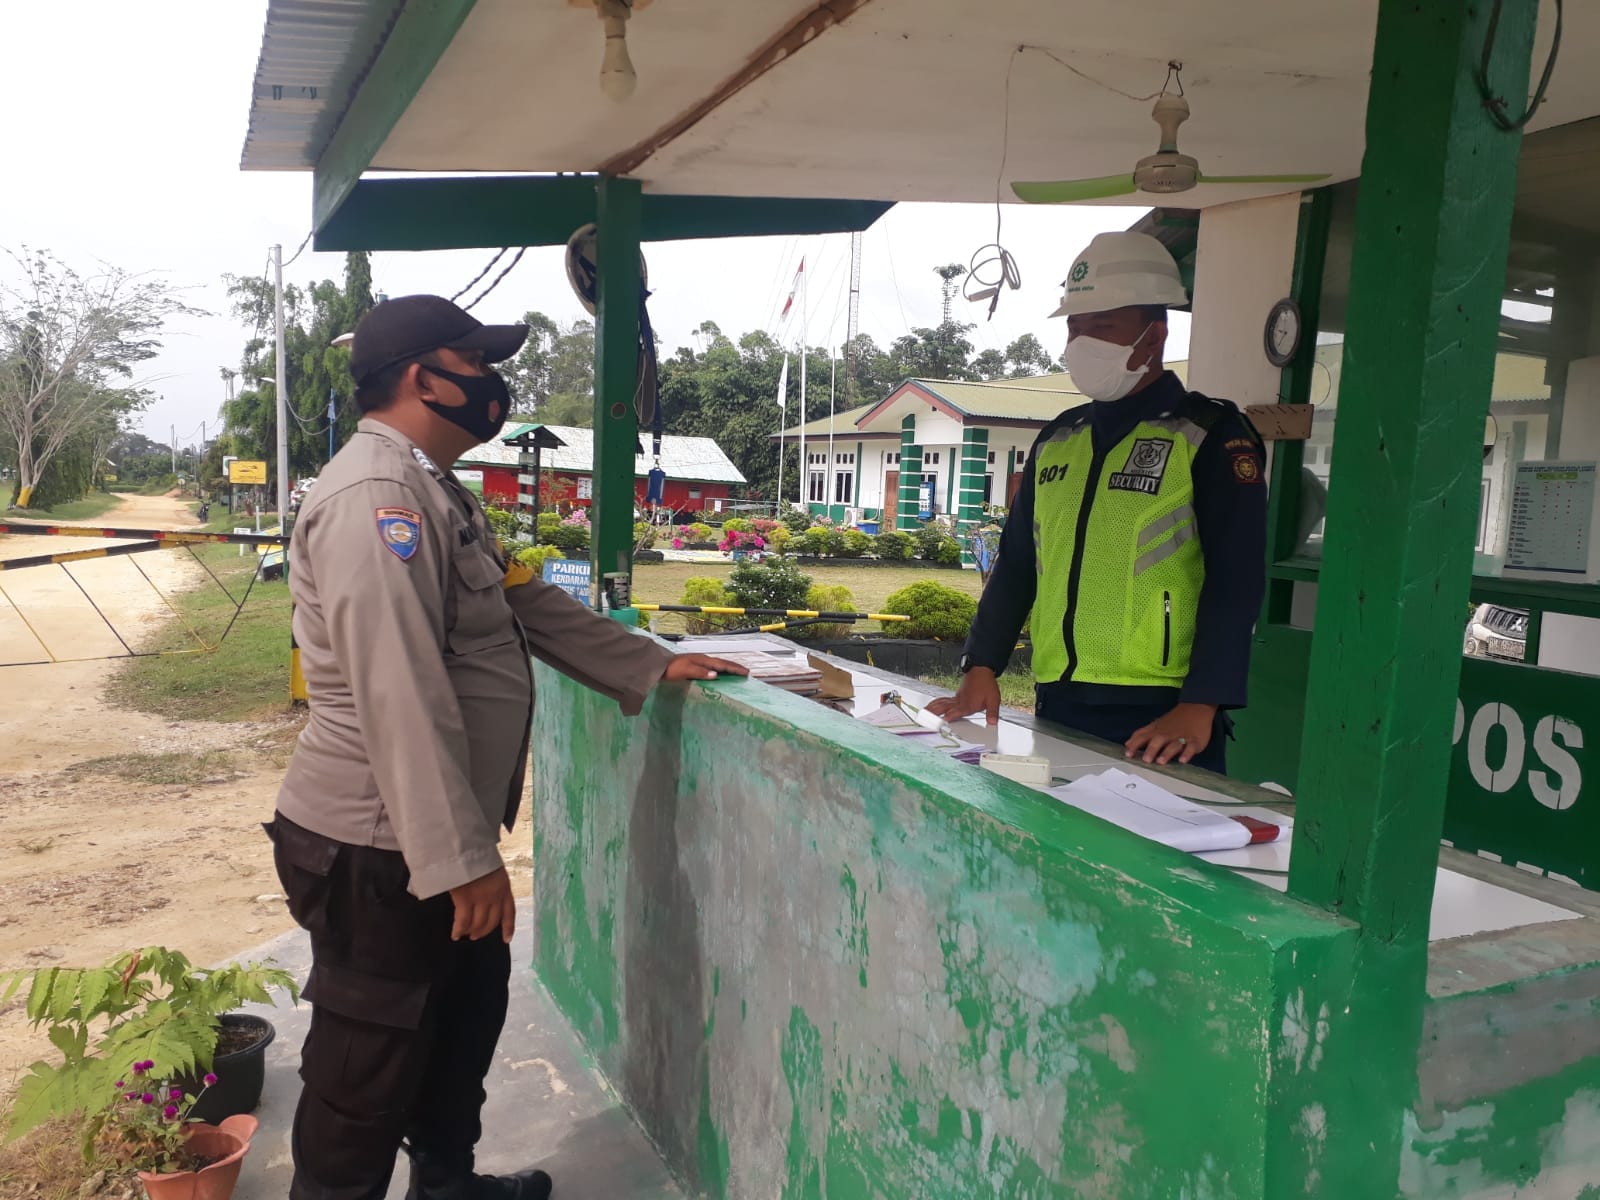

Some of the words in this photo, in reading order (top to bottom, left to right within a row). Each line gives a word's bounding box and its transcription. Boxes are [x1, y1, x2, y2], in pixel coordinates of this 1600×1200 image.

[1039, 463, 1069, 485] 801
[1110, 474, 1159, 492] SECURITY
[1453, 697, 1584, 810] OS
